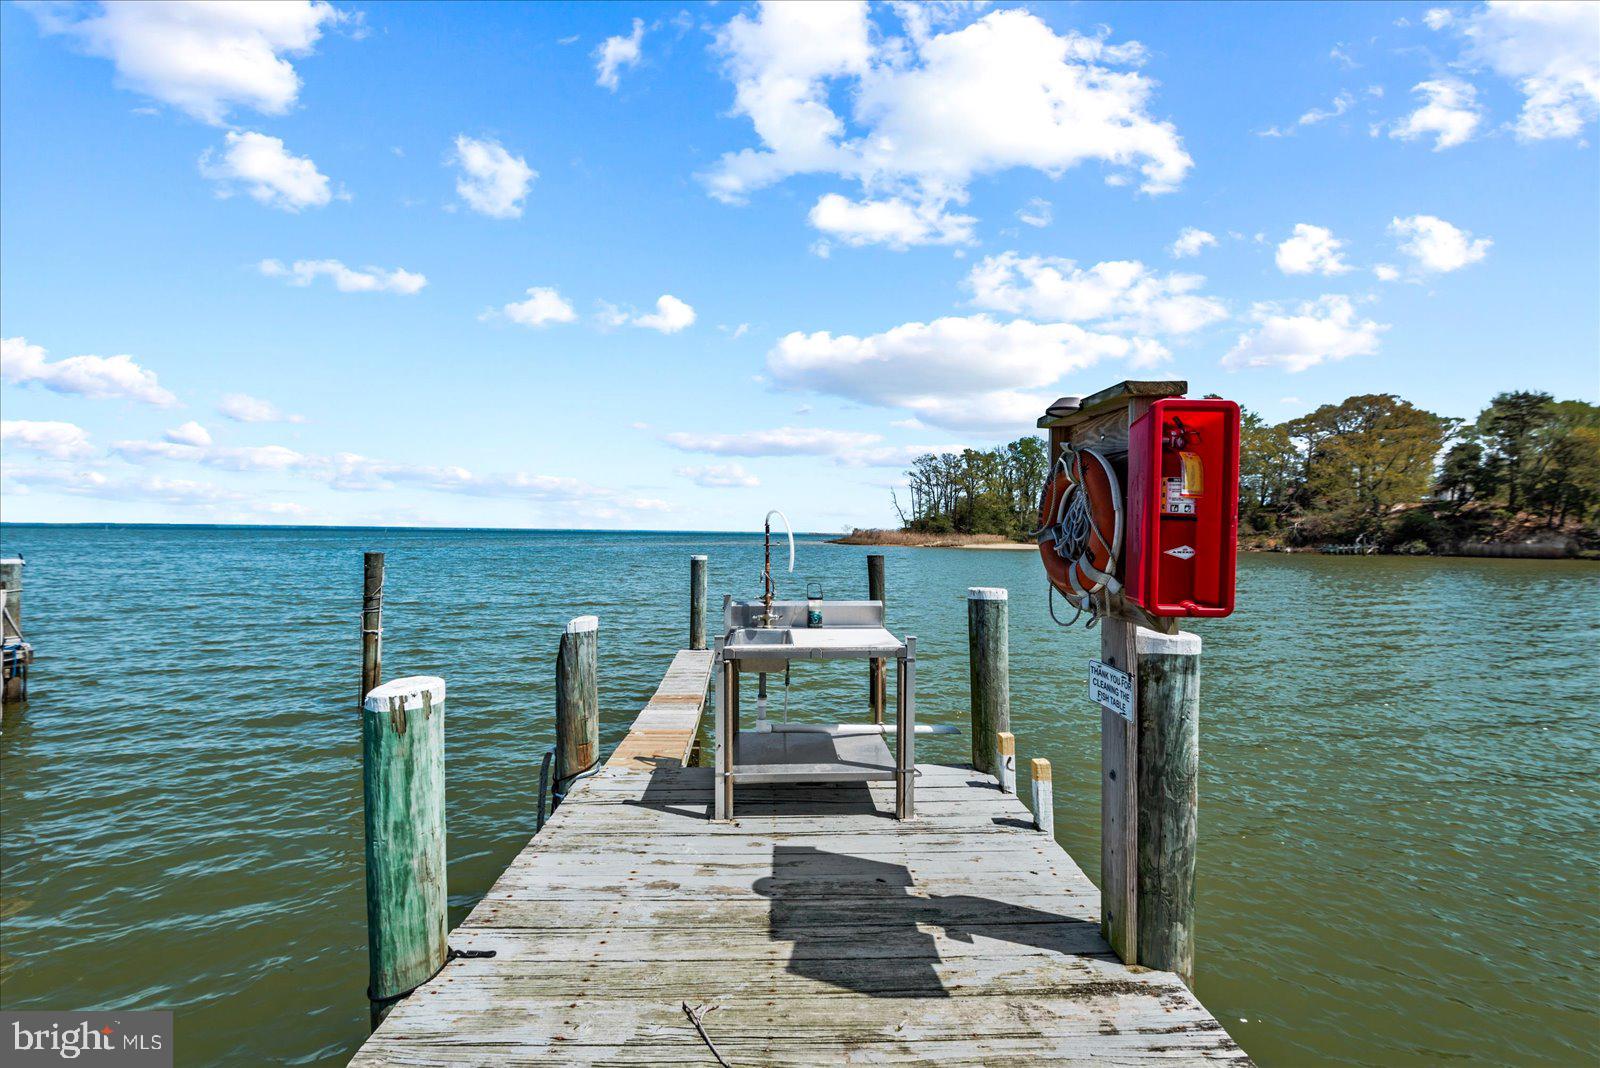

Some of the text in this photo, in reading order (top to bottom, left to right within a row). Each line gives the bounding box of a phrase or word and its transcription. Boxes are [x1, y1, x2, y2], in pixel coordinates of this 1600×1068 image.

[1091, 665, 1132, 691] THANK YOU FOR
[1093, 677, 1130, 703] CLEANING THE
[1098, 690, 1126, 712] FISH TABLE
